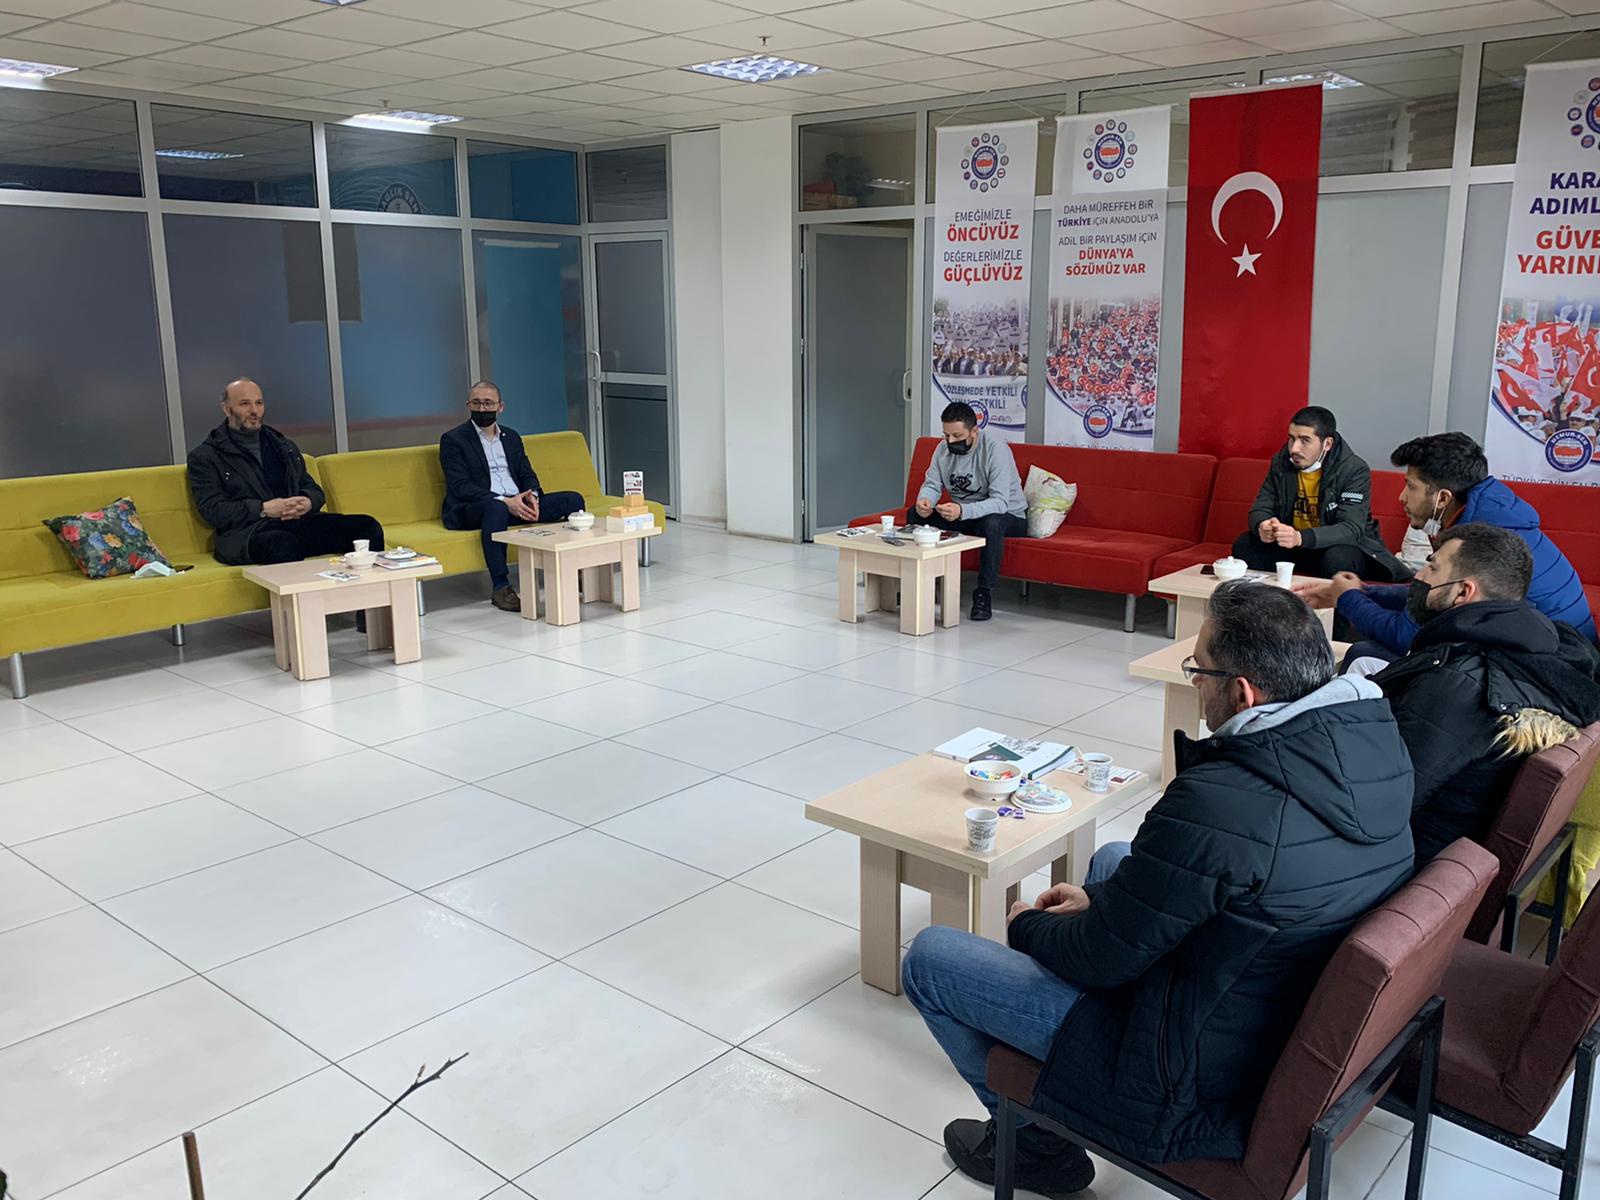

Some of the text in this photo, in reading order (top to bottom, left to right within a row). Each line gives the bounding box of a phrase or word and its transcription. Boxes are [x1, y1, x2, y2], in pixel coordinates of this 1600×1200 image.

[955, 208, 1012, 222] EMEĞİMİZLE
[1063, 204, 1088, 215] DAHA
[1089, 200, 1136, 213] MÜREFFEH
[1057, 216, 1092, 228] TÜRKİYE
[1109, 212, 1159, 225] ANADOLU'YA
[947, 220, 1019, 242] ÖNCÜYÜZ
[1536, 224, 1600, 250] GÜVE
[1095, 233, 1137, 245] PAYLAŞIM
[943, 248, 1023, 263] DEĞERLERİMİZLE
[1079, 246, 1135, 260] DÜNYA'YA
[1065, 261, 1146, 276] SÖZÜMÜZ VAR
[1517, 254, 1600, 274] YARIN
[943, 262, 1023, 286] GÜÇLÜYÜZ
[985, 384, 1018, 397] YETKİLİ
